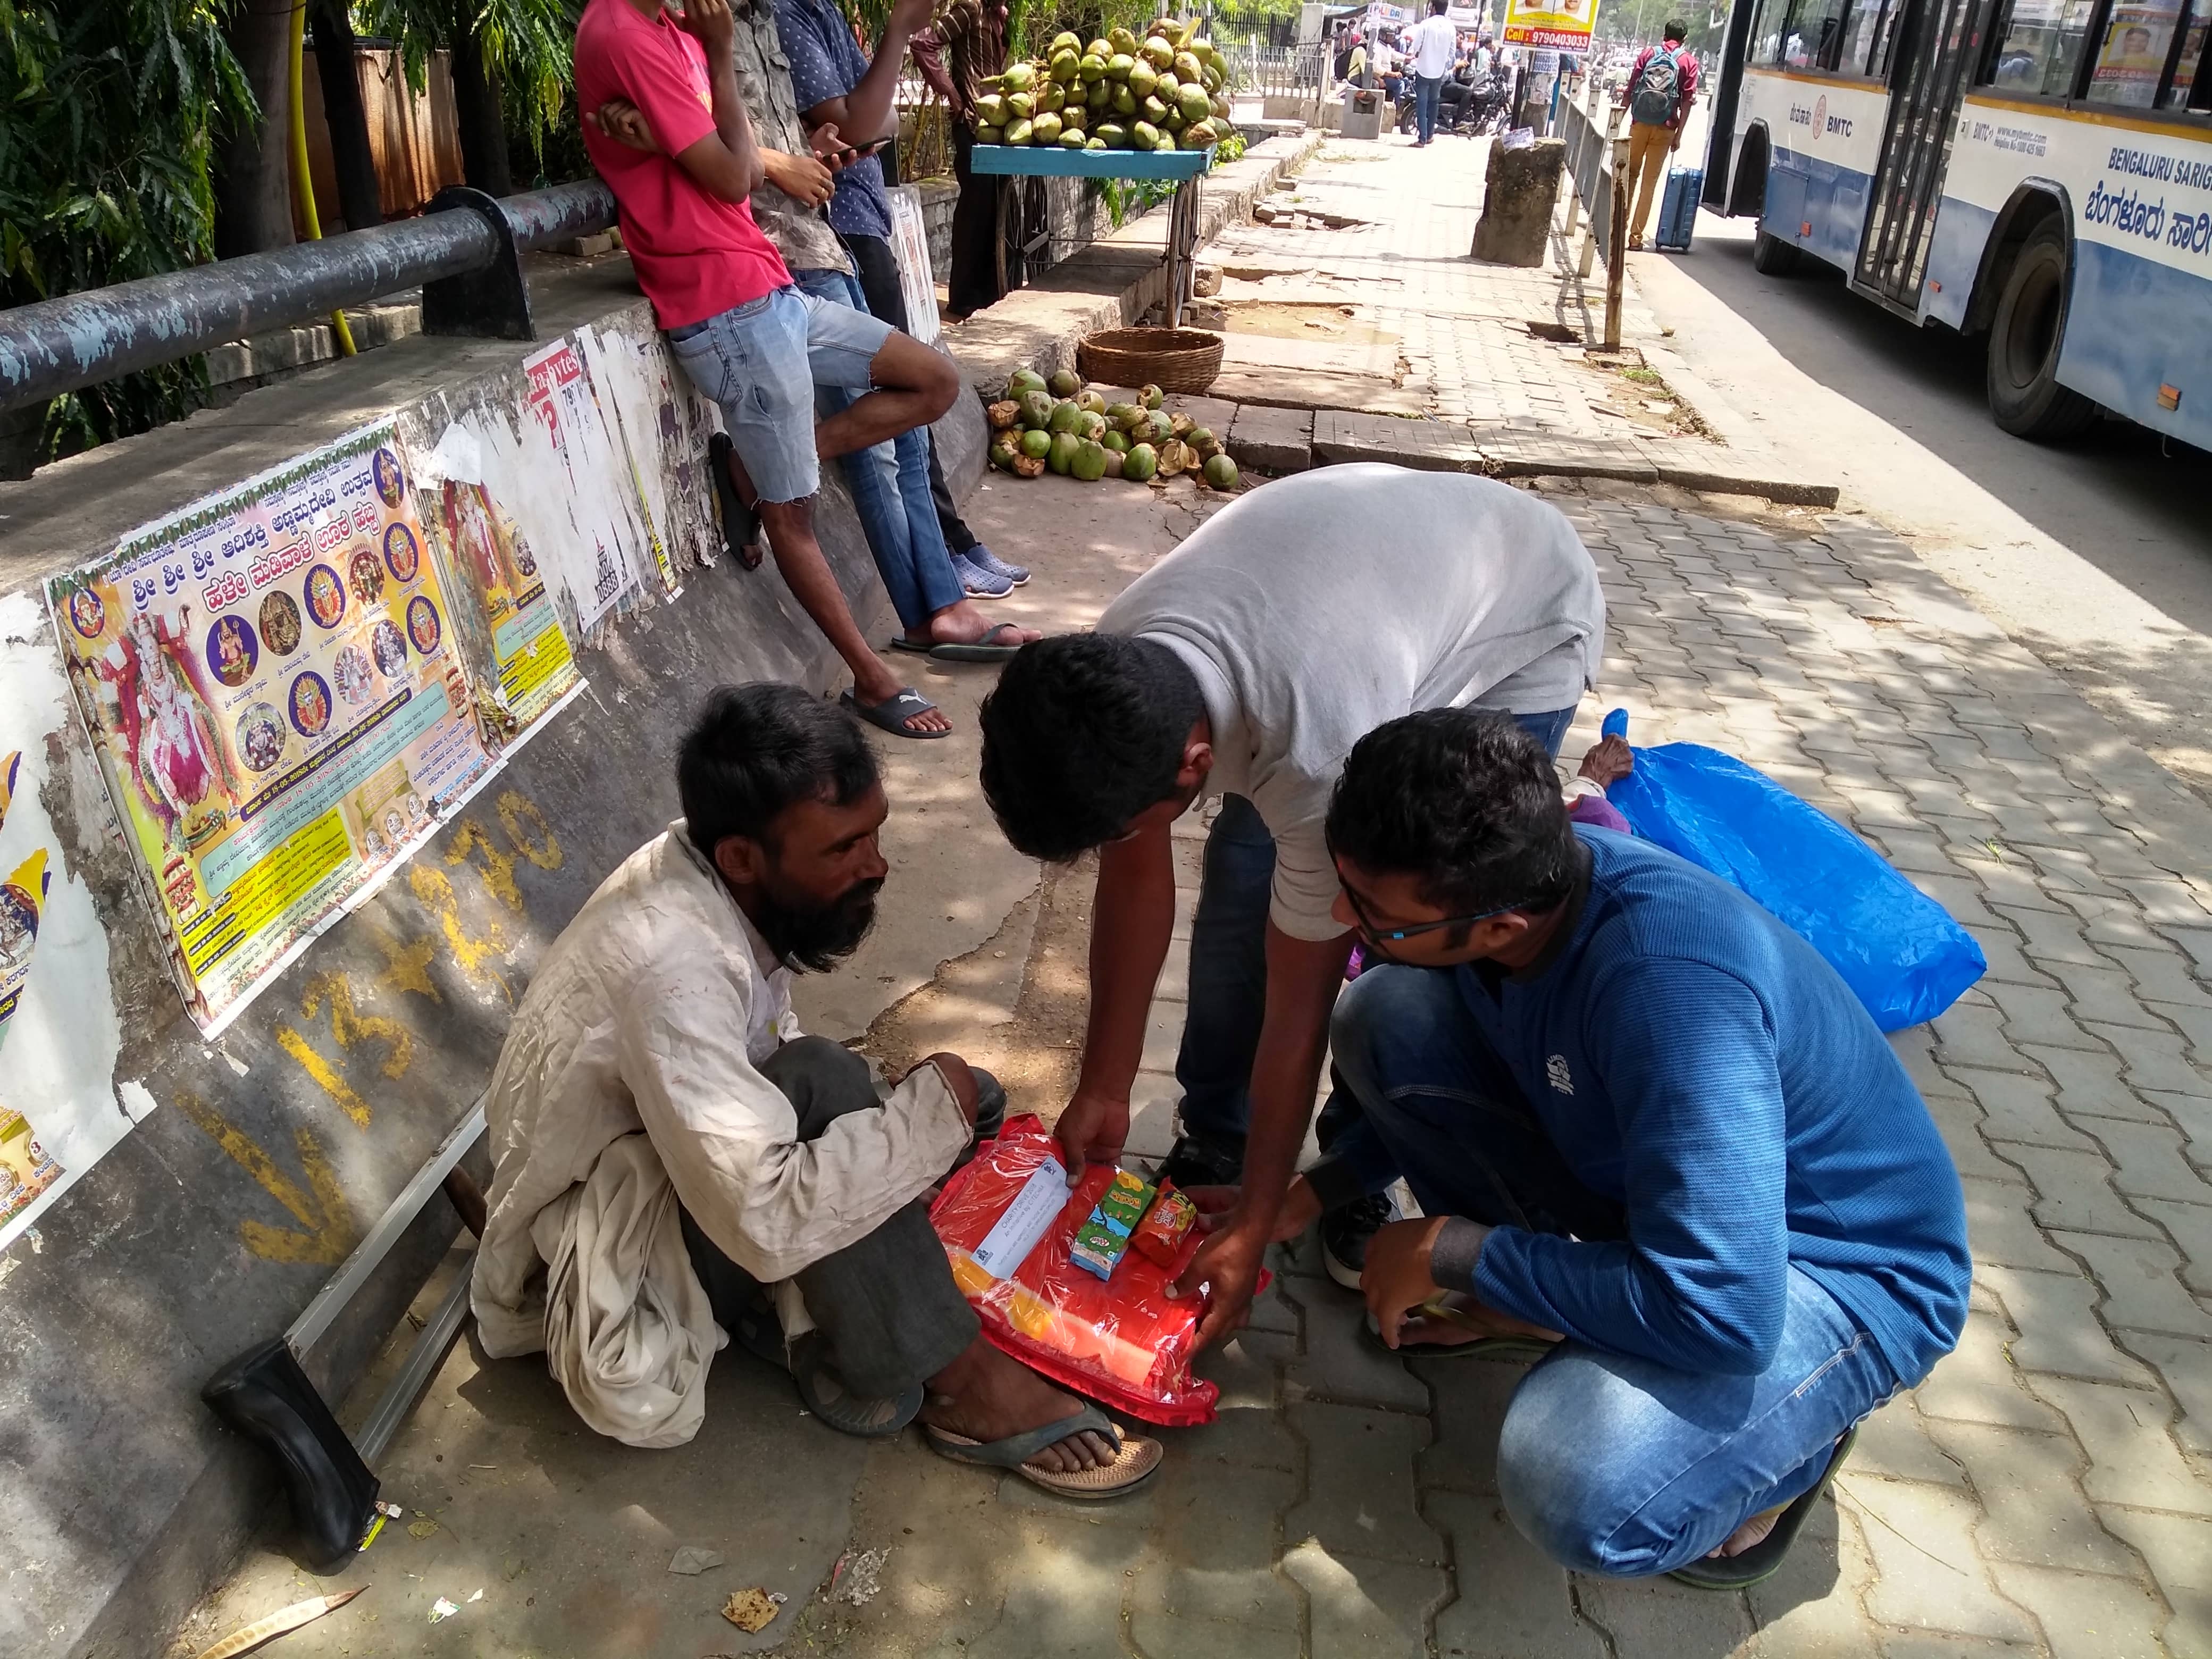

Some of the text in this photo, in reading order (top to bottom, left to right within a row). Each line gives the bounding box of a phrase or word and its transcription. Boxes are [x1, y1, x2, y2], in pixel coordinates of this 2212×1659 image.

[1506, 28, 1524, 41] Cell
[1532, 31, 1588, 47] 9790403033
[1827, 115, 1853, 137] BMTC
[1973, 122, 1989, 141] BMTC
[2108, 147, 2212, 191] BENGALURU SARIG
[2085, 180, 2212, 256] ಬೆಂಗಳೂರು ಸಾರಿ
[130, 467, 374, 610] ಶ್ರೀ ಶ್ರೀ ಶ್ರೀ ಆದಿಶಕ್ತಿ ಅಣ್ಣಮ್ಮದೇವಿ ಉತ್ಸವ
[203, 499, 380, 613] ಹಳೇ ಮಡಿವಾಳ ಊರ ಹಬ್ಬ
[1002, 1208, 1018, 1228] CHARITY
[1017, 1193, 1028, 1209] DRIVE
